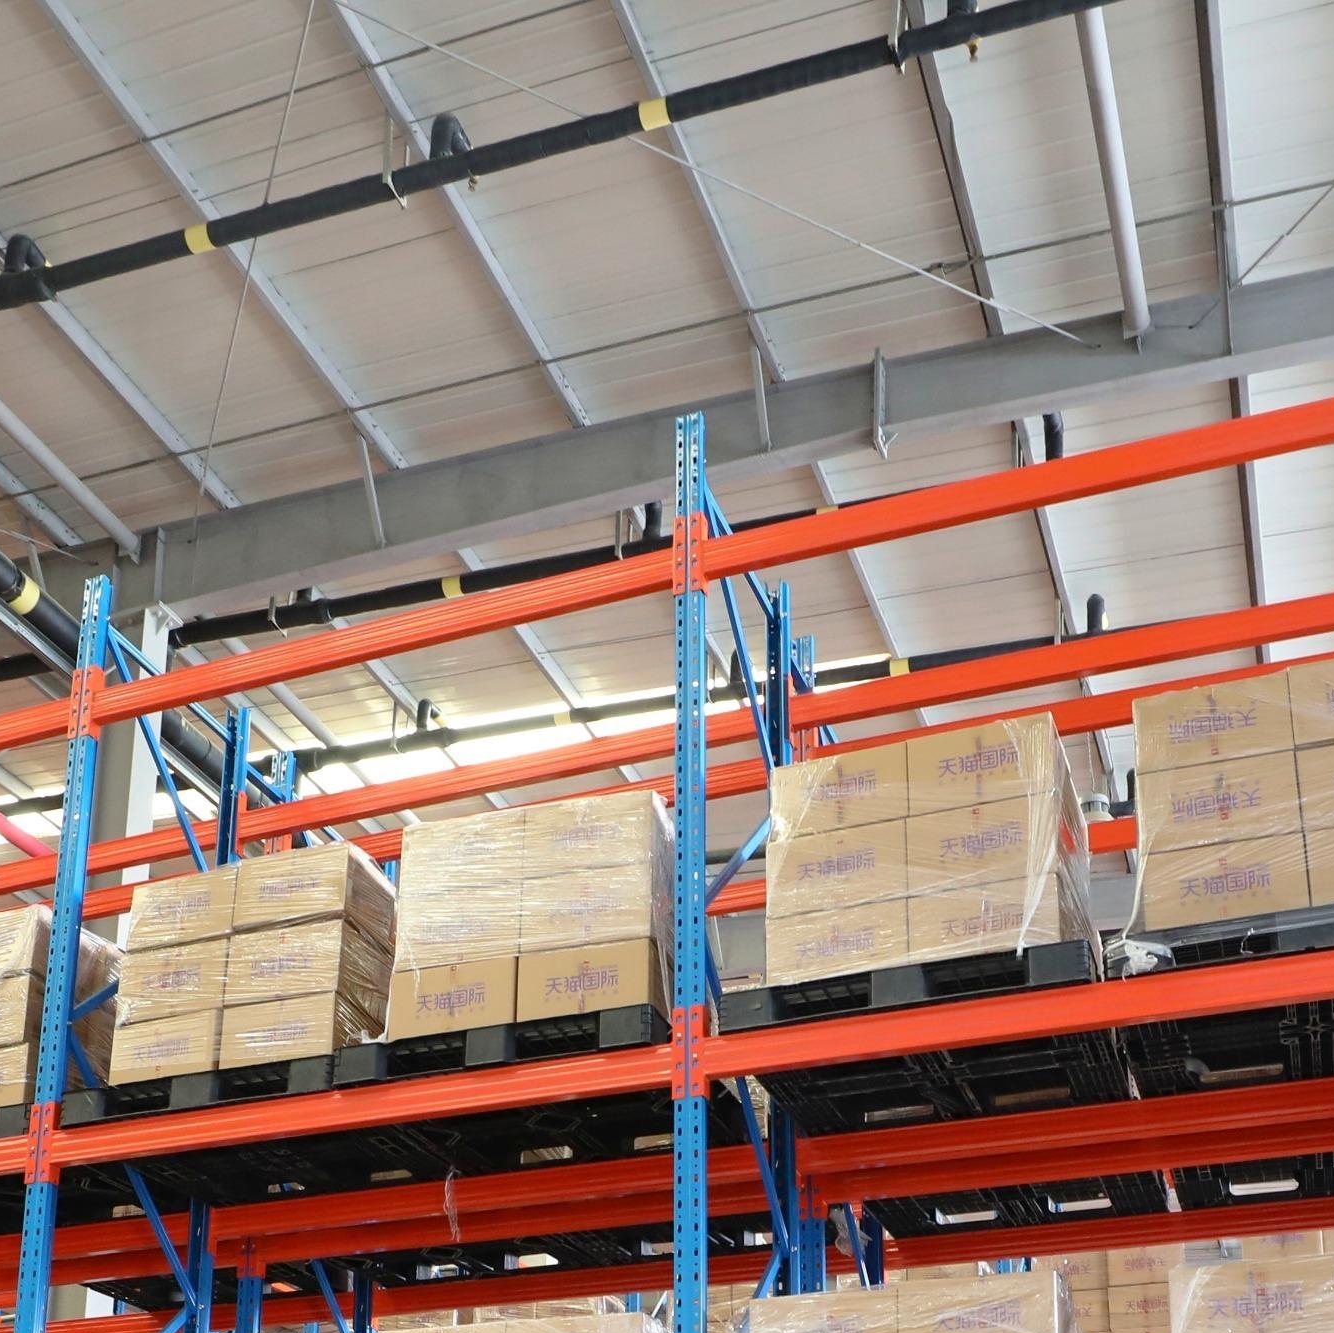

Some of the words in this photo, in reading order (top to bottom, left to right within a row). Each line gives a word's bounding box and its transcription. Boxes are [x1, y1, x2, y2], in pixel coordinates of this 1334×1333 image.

[1179, 870, 1271, 899] 天猫国际
[545, 969, 619, 995] 天猫国际
[417, 985, 485, 1011] 天猫国际
